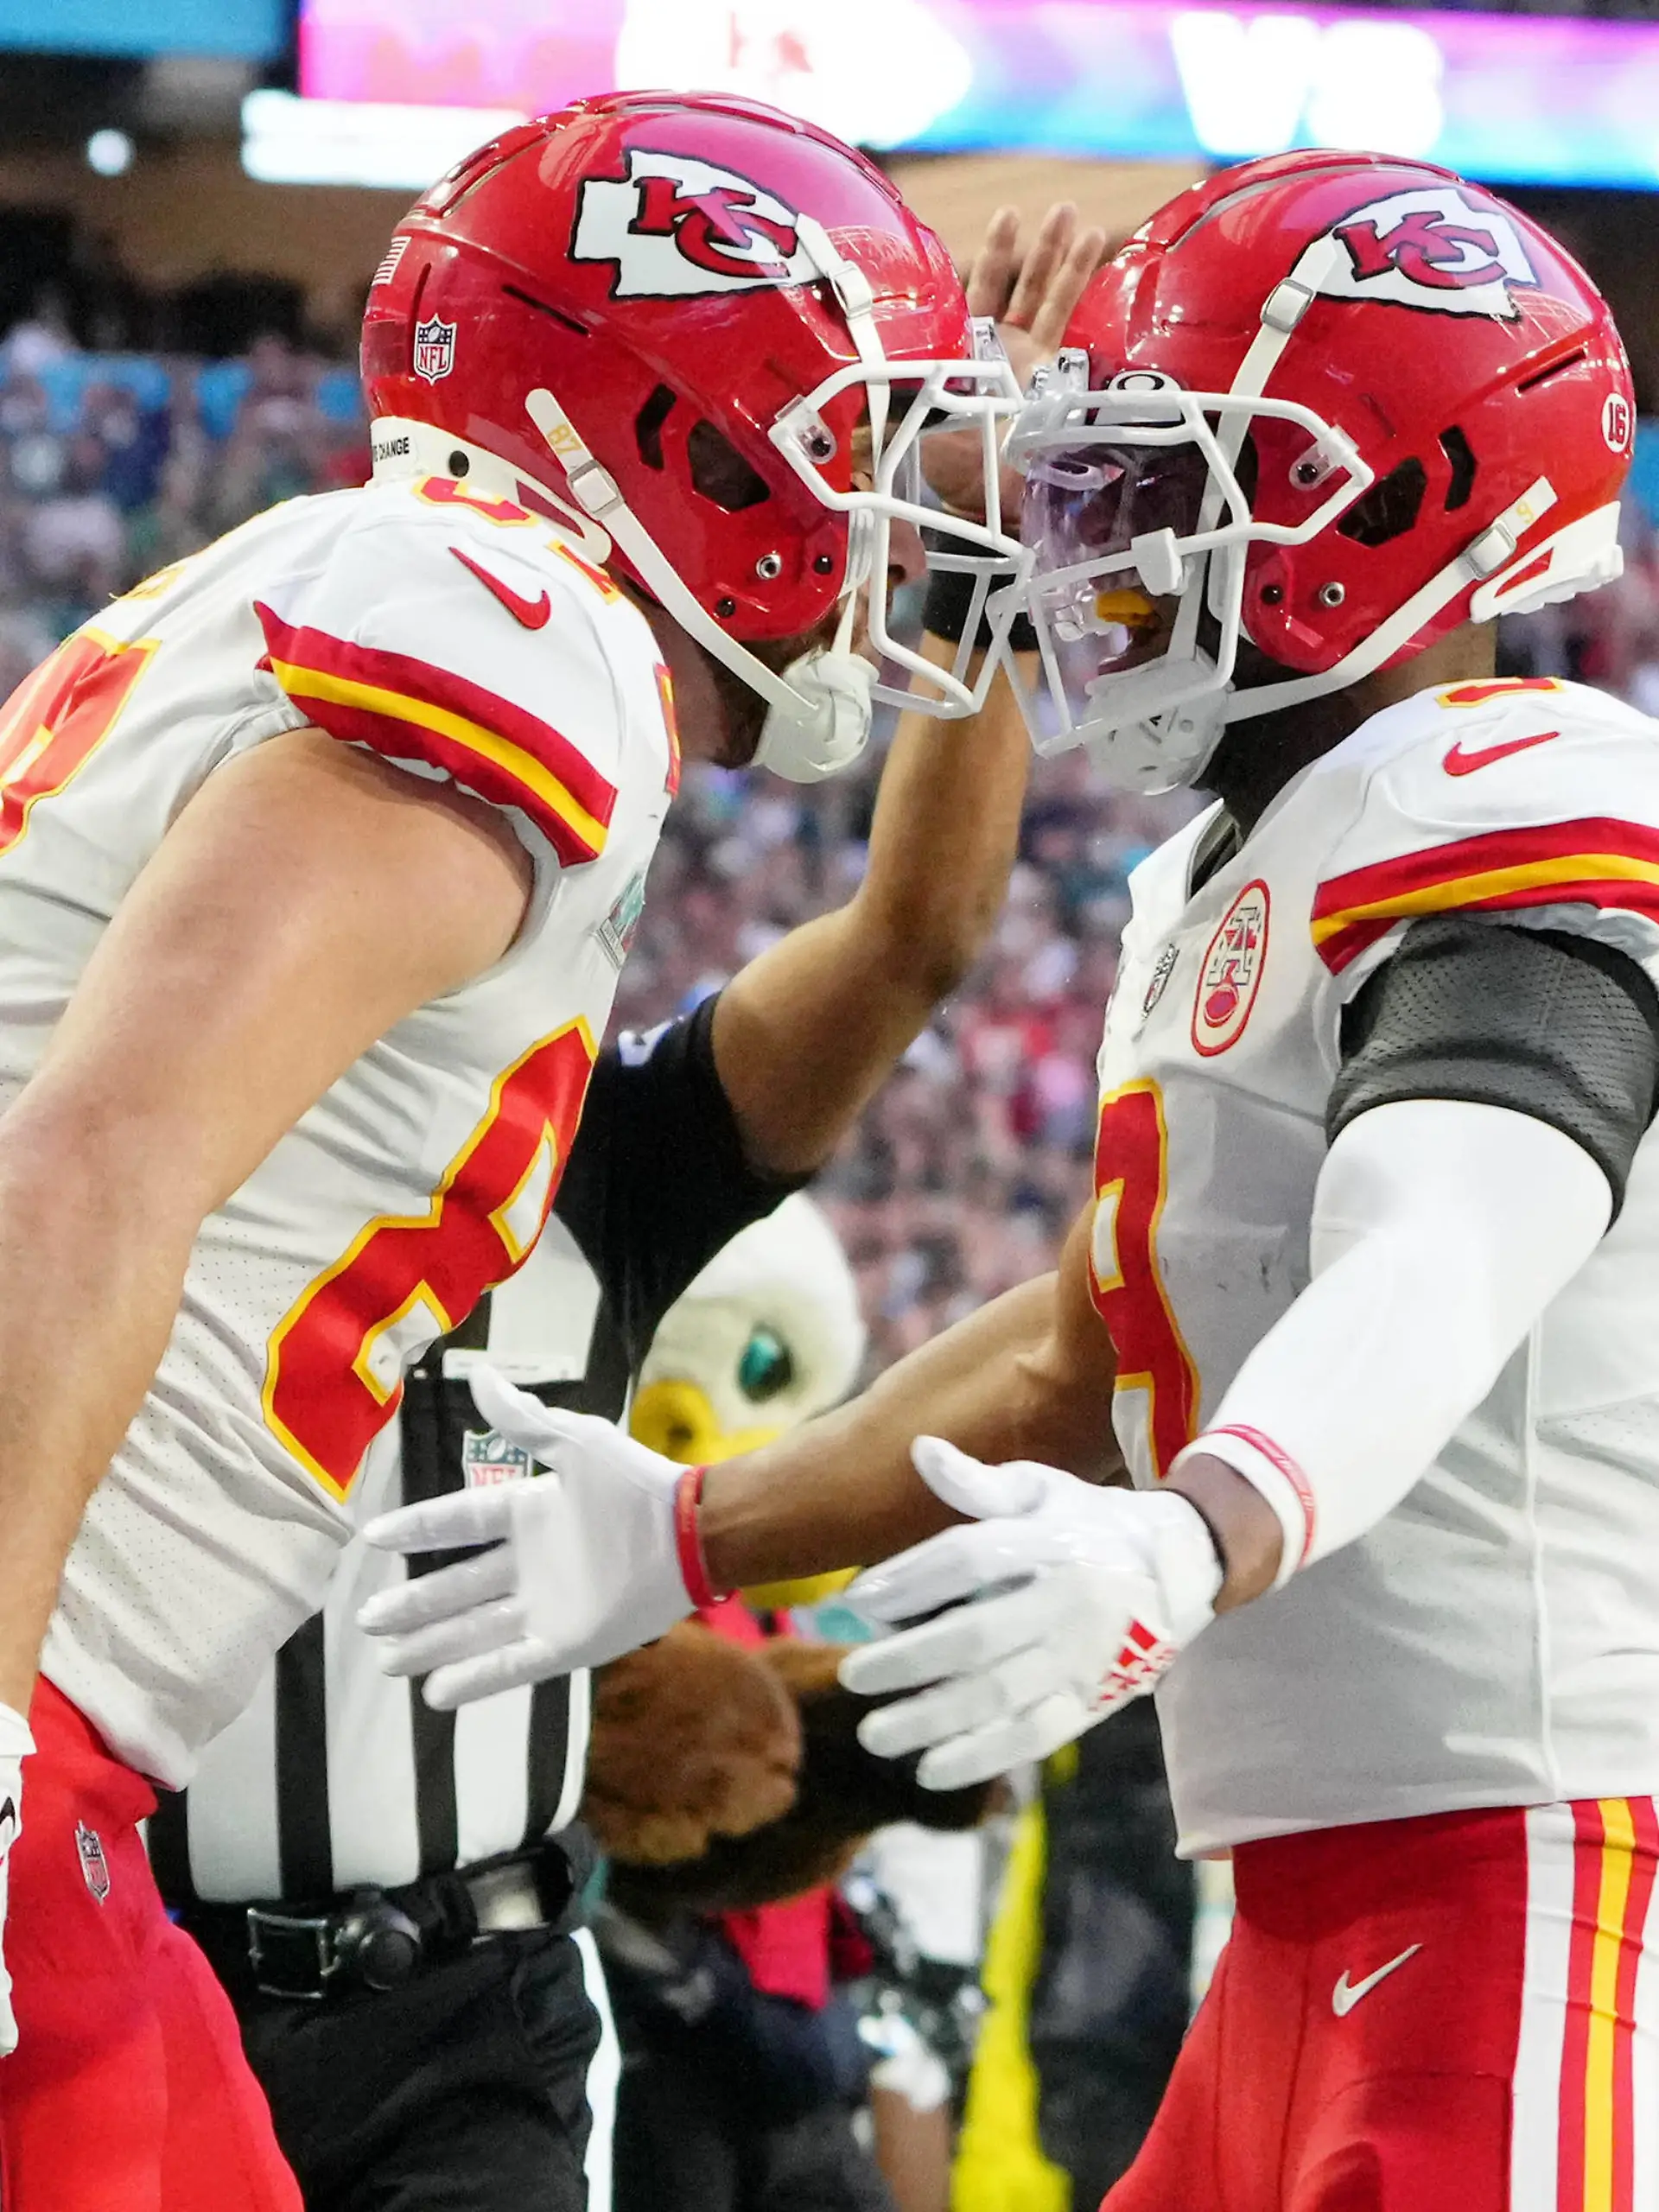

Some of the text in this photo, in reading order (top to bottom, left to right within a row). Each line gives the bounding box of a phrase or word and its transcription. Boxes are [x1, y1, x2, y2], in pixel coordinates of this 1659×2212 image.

[627, 175, 799, 278] KC
[1332, 210, 1508, 290] KC
[419, 346, 447, 372] NFL
[548, 424, 583, 455] 87
[1608, 402, 1626, 444] 16
[378, 436, 410, 462] CHANGE
